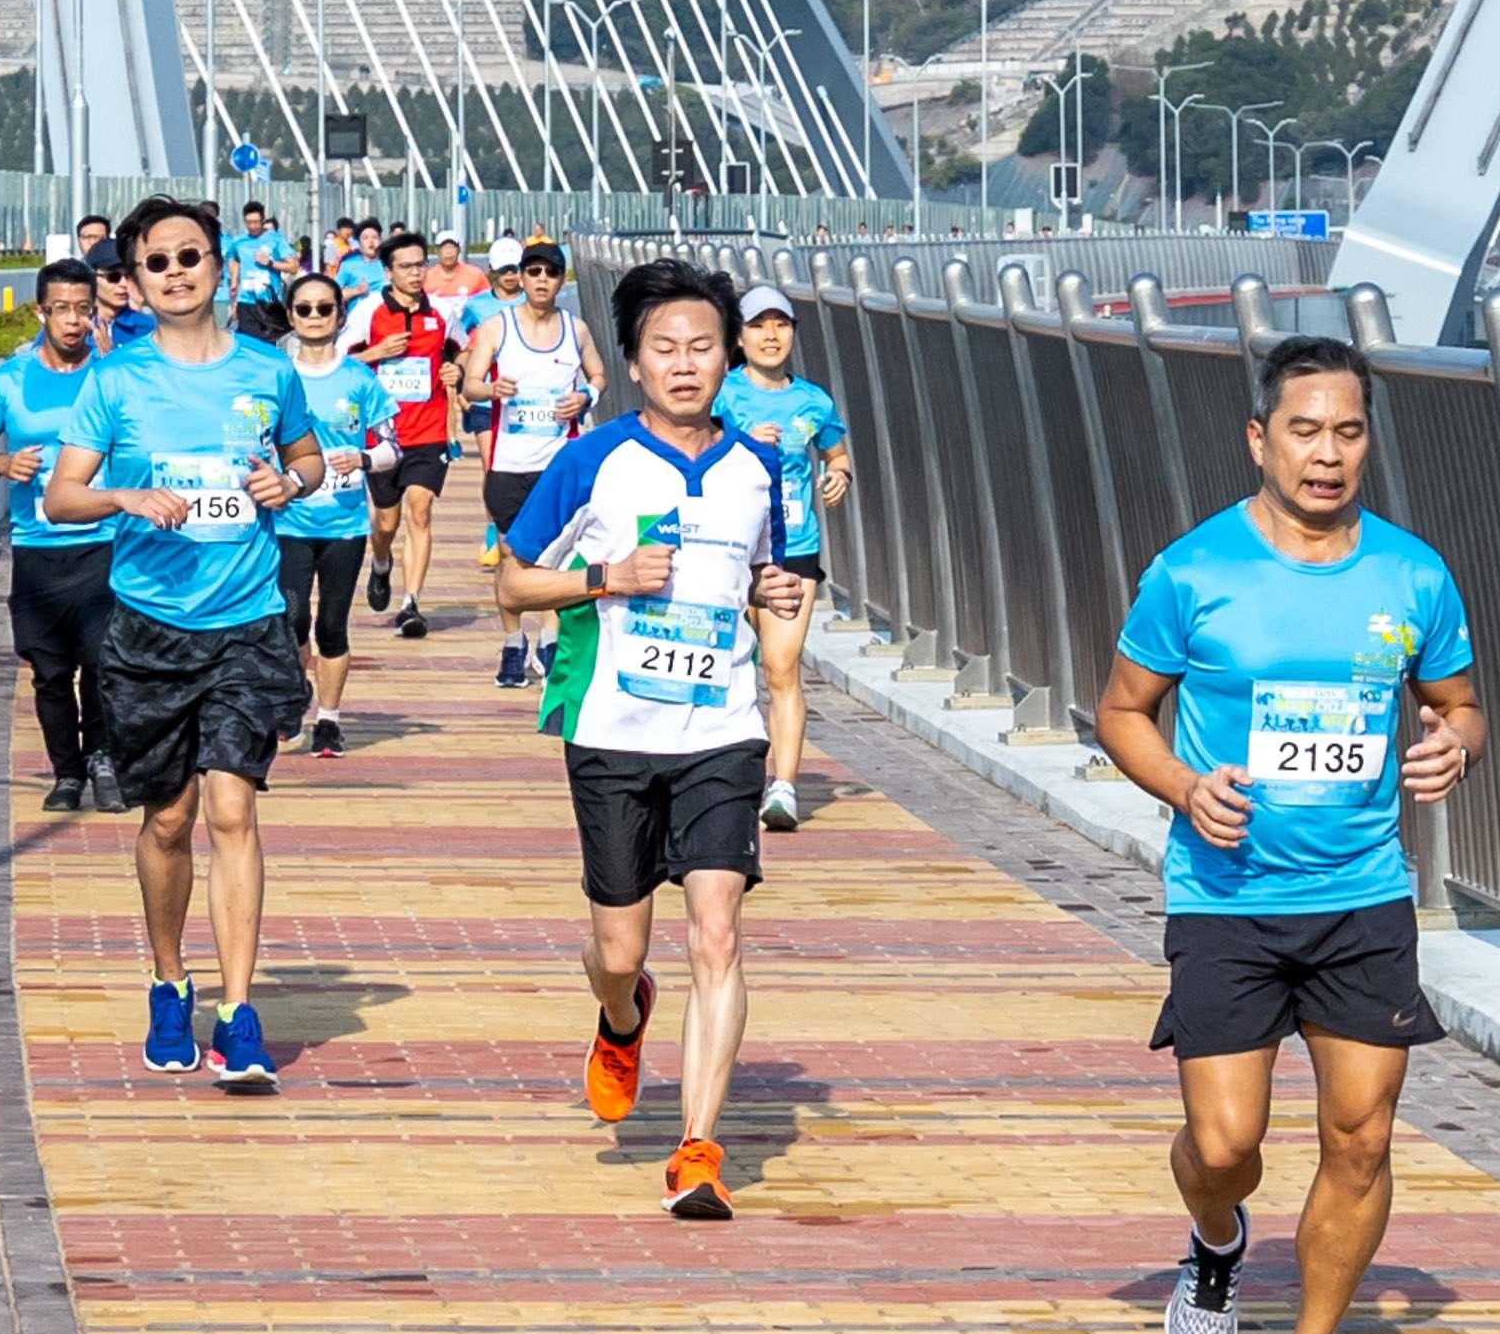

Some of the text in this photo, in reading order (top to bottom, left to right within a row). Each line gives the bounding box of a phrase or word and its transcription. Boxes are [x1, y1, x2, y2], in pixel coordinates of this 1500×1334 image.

[192, 496, 240, 518] 156
[641, 645, 715, 679] 2112
[1278, 741, 1364, 774] 2135
